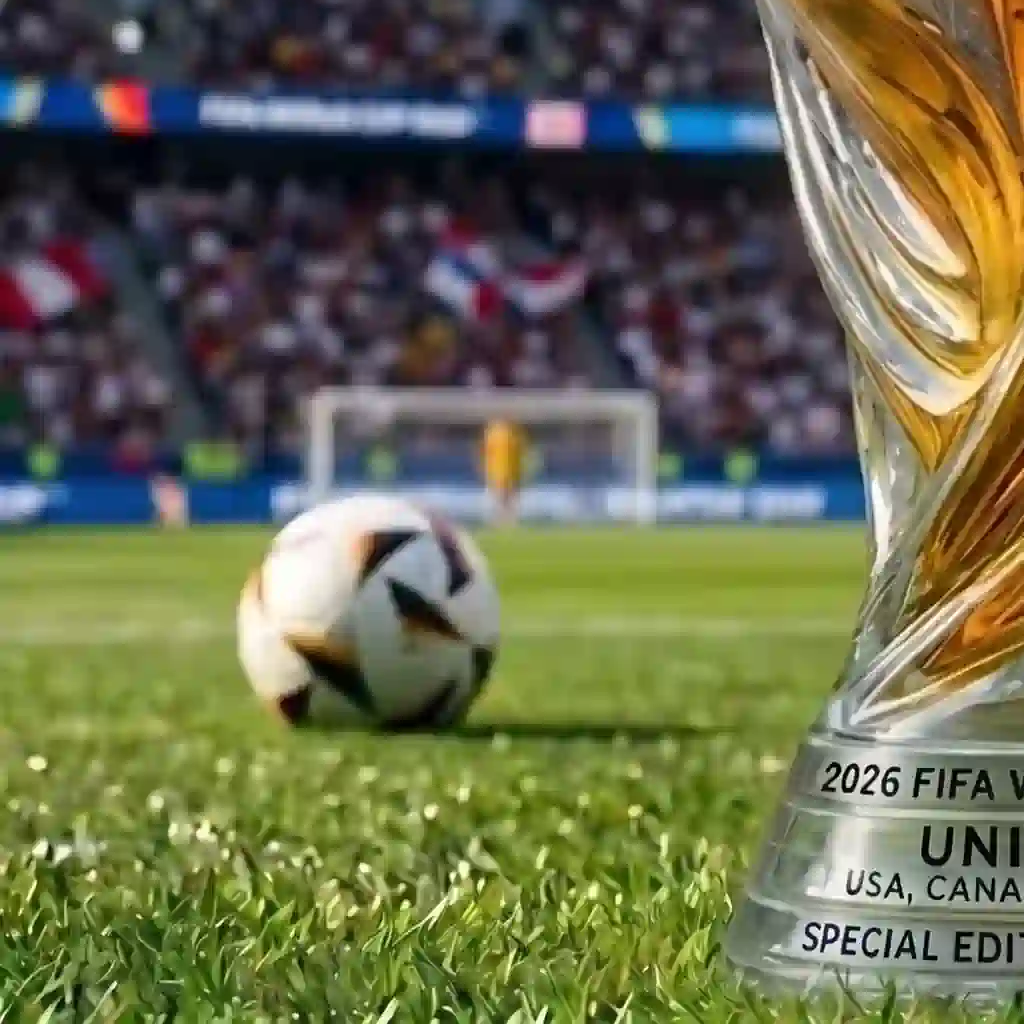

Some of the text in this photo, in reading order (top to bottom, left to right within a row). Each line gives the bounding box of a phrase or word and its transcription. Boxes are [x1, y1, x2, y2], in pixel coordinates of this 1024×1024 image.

[821, 762, 901, 797] 2026
[912, 768, 996, 800] FIFA
[845, 869, 913, 906] USA,
[801, 921, 939, 961] SPECIAL
